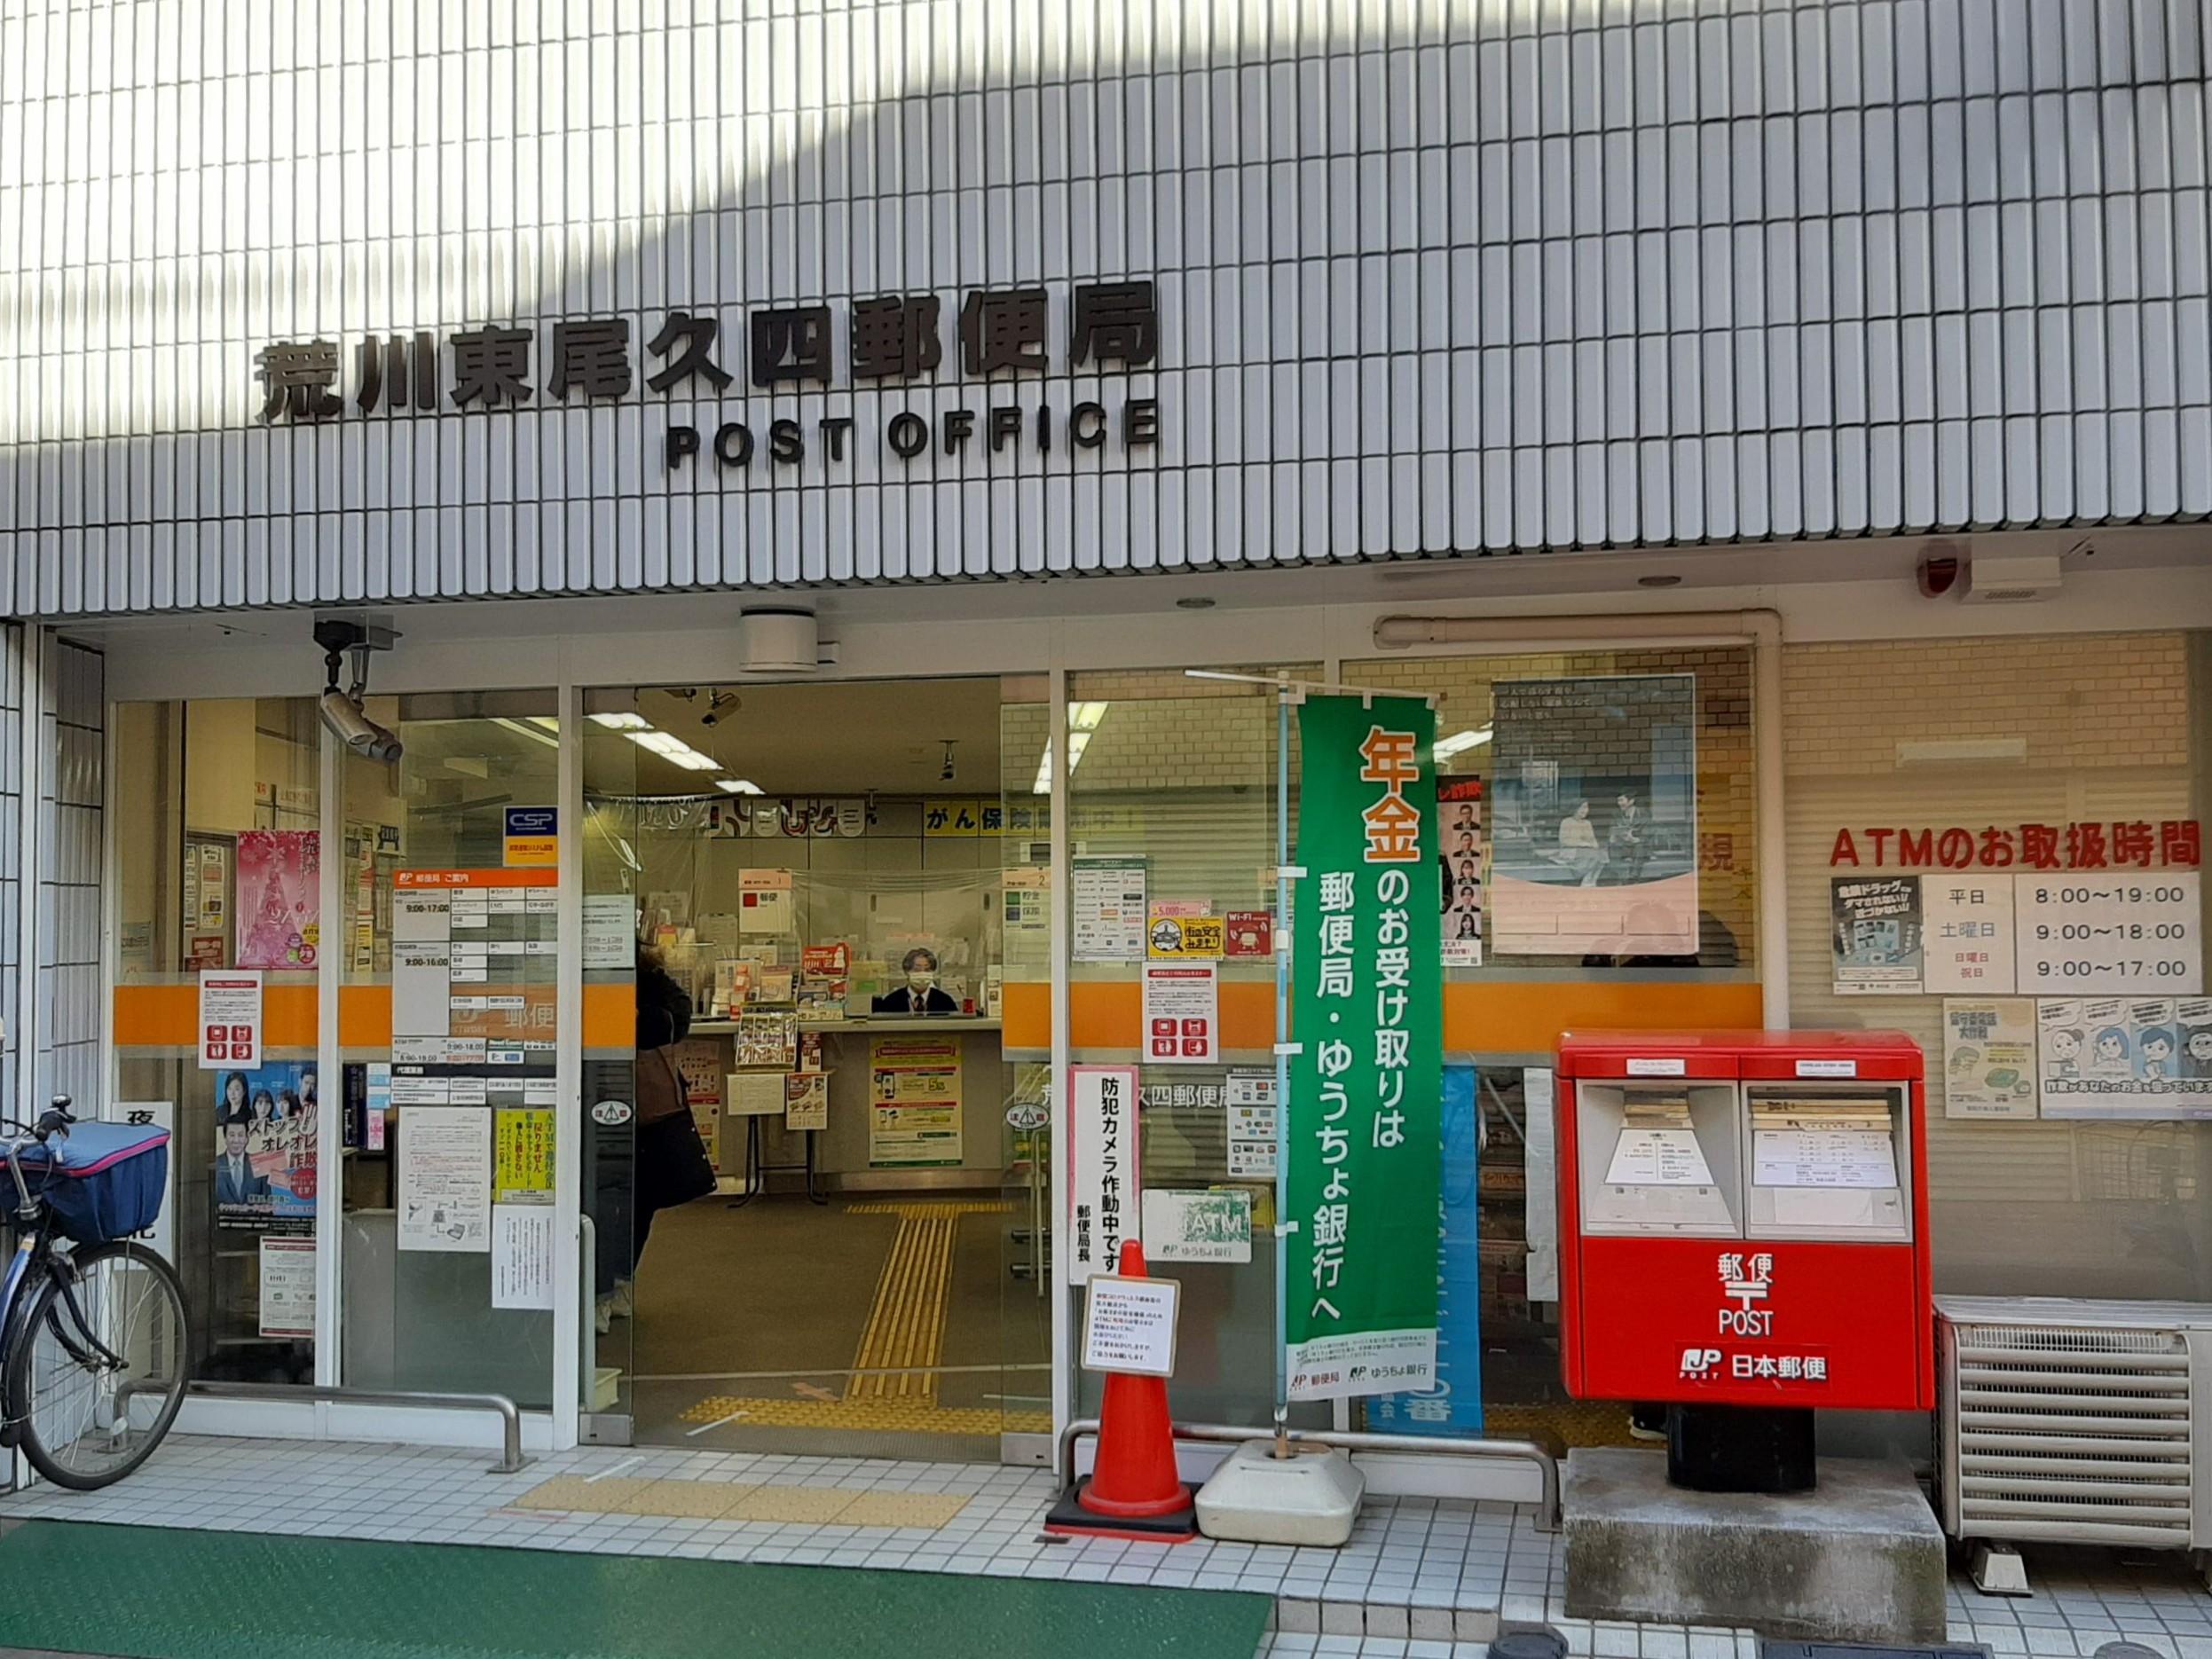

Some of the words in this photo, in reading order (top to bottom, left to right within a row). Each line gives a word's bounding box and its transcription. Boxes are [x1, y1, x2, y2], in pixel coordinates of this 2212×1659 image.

[254, 282, 1157, 424] 荒川東尾久四郵便局
[666, 415, 854, 468] POST
[887, 398, 1160, 458] OFFICE
[509, 814, 553, 826] CSP
[1830, 821, 2200, 869] ATMのお取扱時間
[416, 874, 440, 883] 郵便局
[445, 874, 469, 883] ご案内
[1039, 875, 1045, 885] 2
[1948, 889, 1985, 905] 平日
[406, 904, 449, 913] 9:00-17:00
[1360, 725, 1420, 1148] 年金のお受け取りは
[1940, 924, 1996, 939] 土曜日
[1955, 952, 1989, 963] 日曜日
[1961, 967, 1984, 979] 祝日
[1311, 872, 1355, 1320] 郵便局・ゆうちょ銀行へ
[261, 1135, 317, 1152] オレオレ
[1101, 1078, 1120, 1271] 防犯カメラ作動中です
[1192, 1214, 1242, 1233] ATM
[1077, 1205, 1090, 1262] 郵便局長
[1182, 1246, 1232, 1256] ゆうちょ銀行
[1718, 1254, 1773, 1283] 郵便
[1719, 1309, 1774, 1336] POST
[1311, 1372, 1340, 1386] 郵便局
[1371, 1364, 1428, 1379] ゆうちょ銀行
[1679, 1371, 1720, 1380] POST
[1732, 1356, 1827, 1380] 日本郵便
